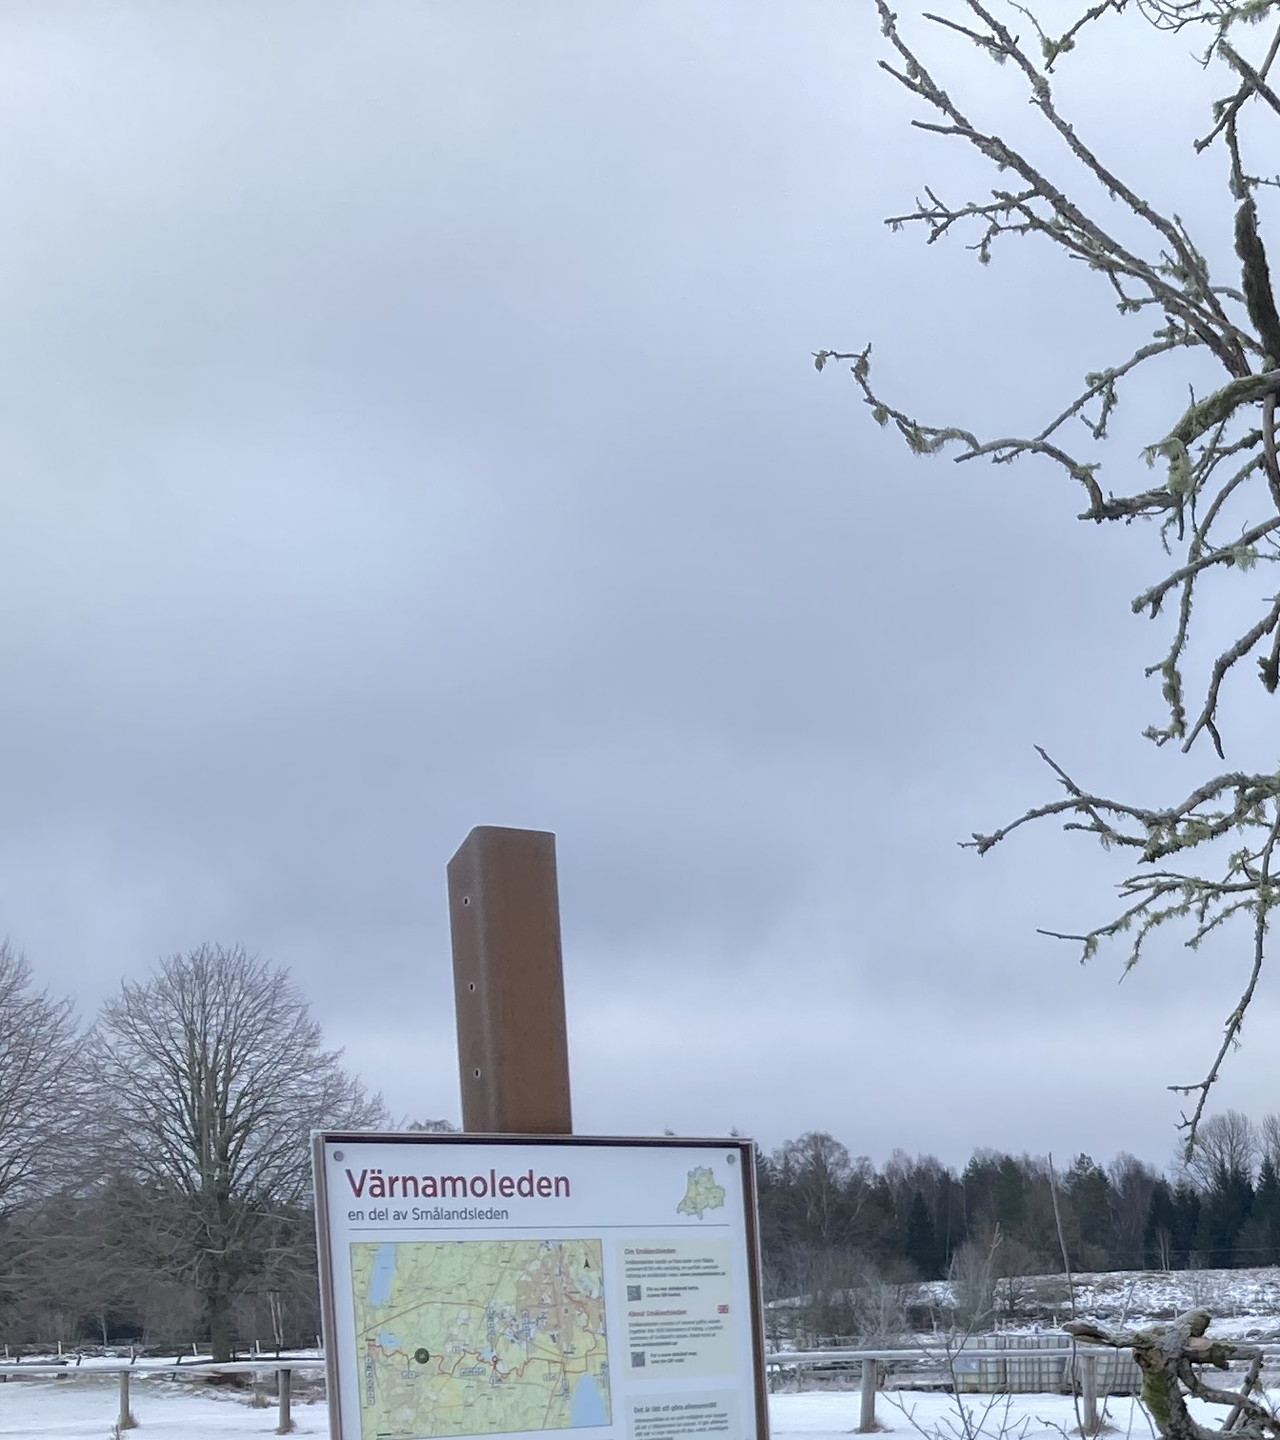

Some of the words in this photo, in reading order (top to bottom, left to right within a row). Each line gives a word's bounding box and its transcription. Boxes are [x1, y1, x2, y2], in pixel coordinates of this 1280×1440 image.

[345, 1168, 571, 1198] Värnamoleden
[348, 1209, 365, 1221] en
[368, 1208, 389, 1221] del
[392, 1210, 408, 1221] av
[412, 1206, 509, 1221] Smålandsleden
